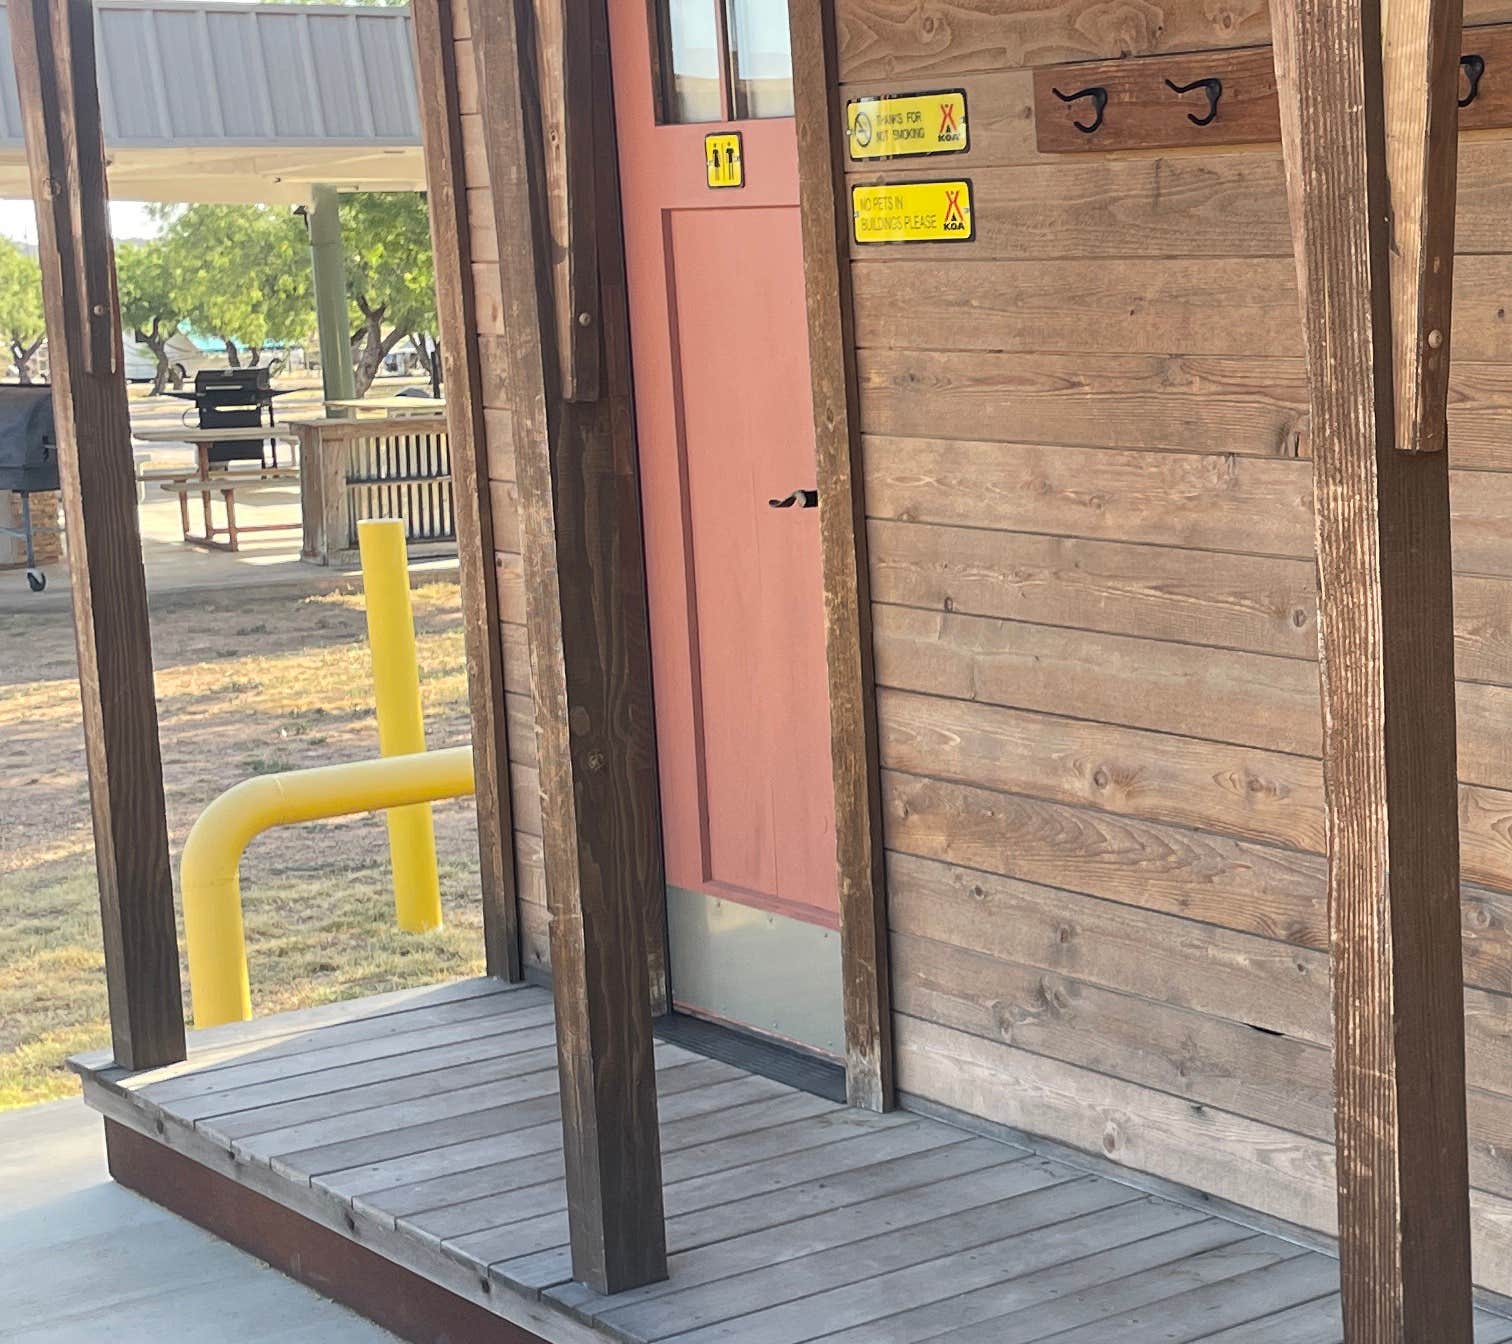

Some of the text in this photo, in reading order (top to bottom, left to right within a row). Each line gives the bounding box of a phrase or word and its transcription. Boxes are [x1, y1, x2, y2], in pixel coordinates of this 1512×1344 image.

[907, 111, 921, 123] FOR
[938, 134, 960, 143] KOA
[943, 222, 965, 231] KOA
